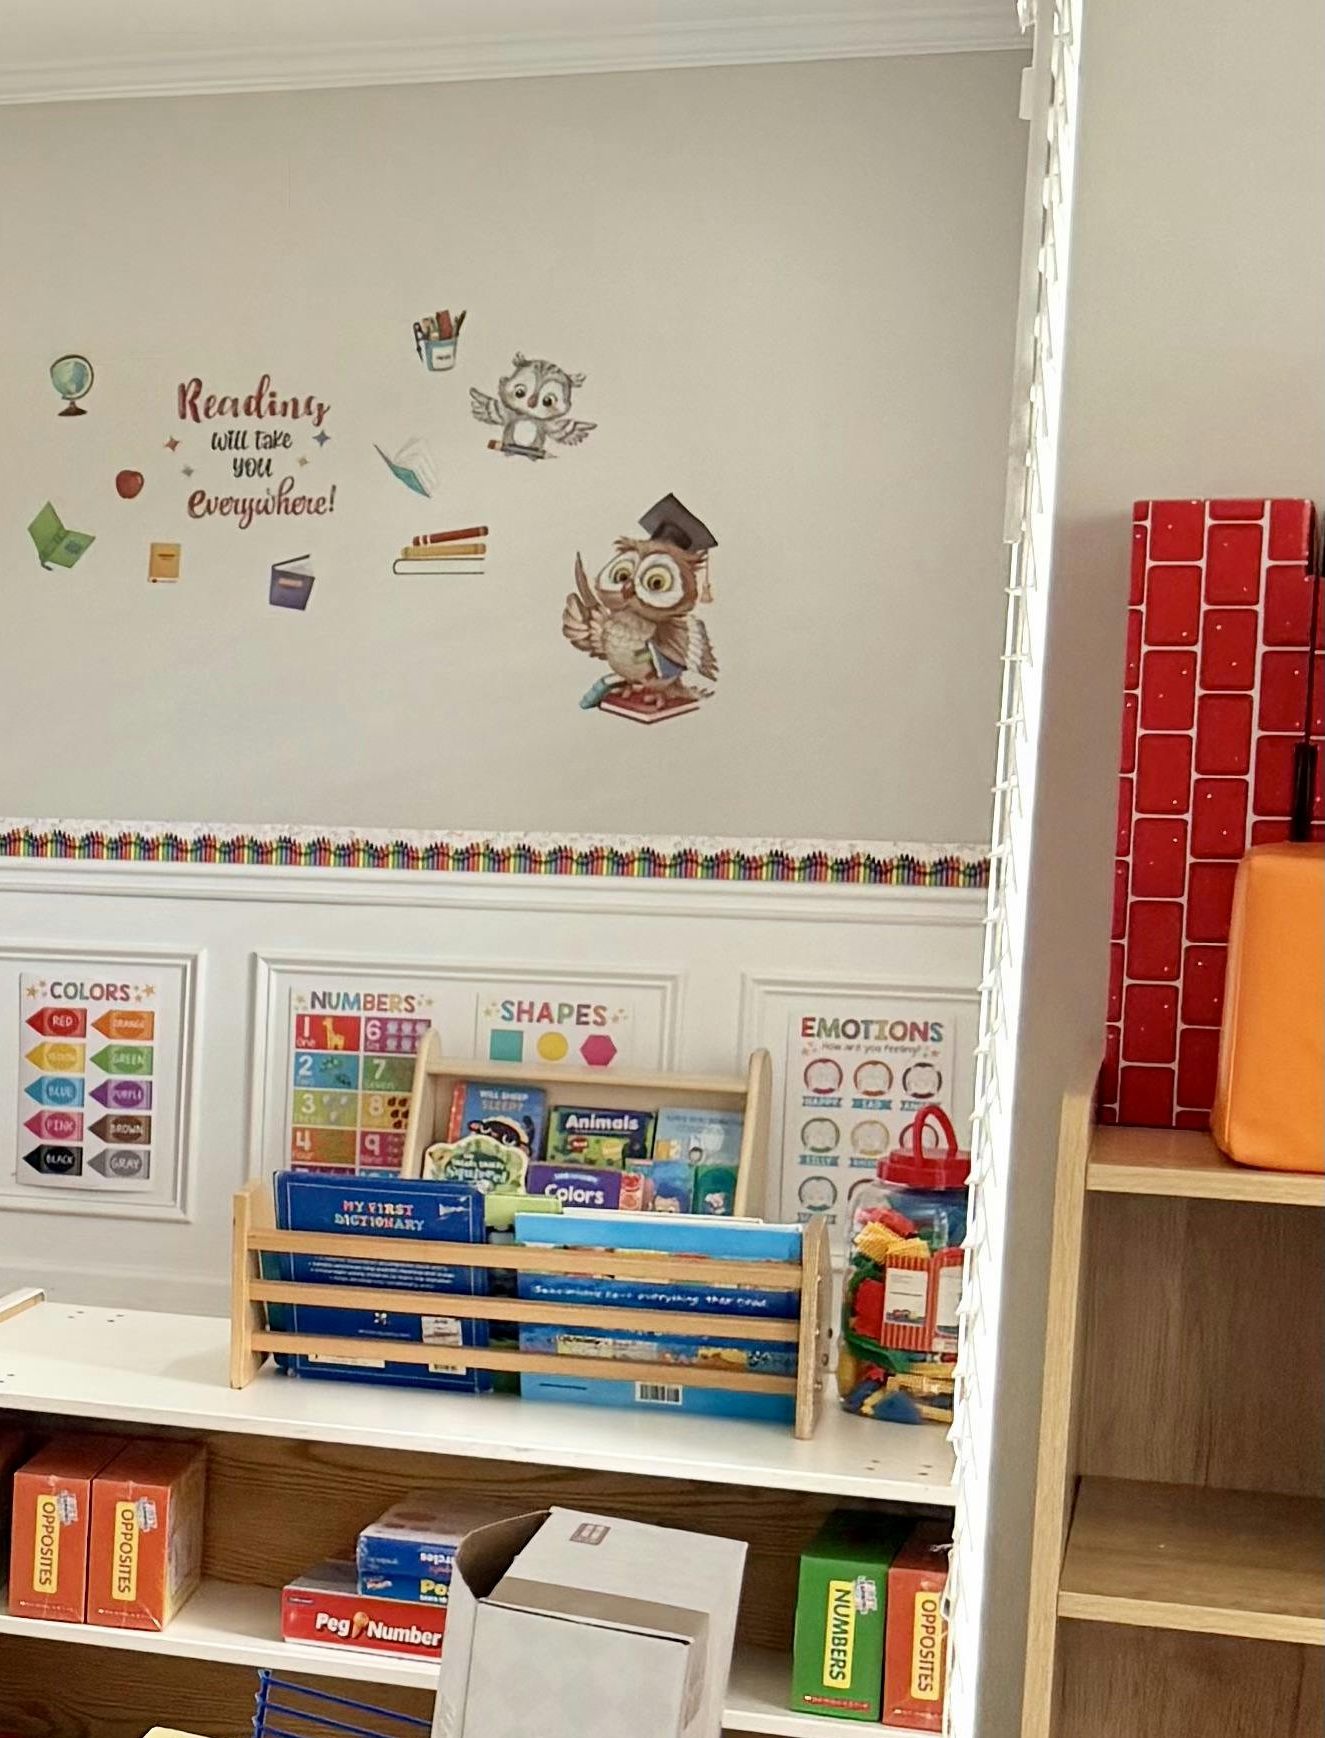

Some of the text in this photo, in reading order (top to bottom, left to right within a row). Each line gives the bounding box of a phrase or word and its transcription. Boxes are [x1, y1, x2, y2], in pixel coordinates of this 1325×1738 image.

[178, 374, 330, 427] Reading
[211, 430, 293, 450] will take
[233, 457, 273, 478] you
[187, 476, 337, 530] everywhere!
[50, 982, 131, 1002] COLORS
[310, 991, 416, 1013] NUMBERS
[52, 1016, 73, 1027] RED
[500, 999, 608, 1026] SHAPES
[303, 1016, 381, 1040] 1 6
[801, 1017, 944, 1042] EMOTIONS
[113, 1053, 144, 1065] GREEN
[298, 1055, 387, 1080] 2 7
[49, 1086, 73, 1098] BLUE
[302, 1093, 383, 1116] 3 8
[47, 1119, 144, 1135] PINK BROWN
[565, 1113, 639, 1131] Animals
[296, 1129, 380, 1155] 4 9
[46, 1154, 141, 1170] BLACK GRAY
[544, 1184, 604, 1205] Colors
[343, 1200, 414, 1218] MY FIRST
[335, 1213, 425, 1232] DICTIONARY
[38, 1501, 56, 1587] OPPOSITES
[117, 1508, 134, 1594] OPPOSITES
[315, 1612, 443, 1647] Peg Number
[829, 1588, 851, 1682] NUMBERS
[917, 1599, 937, 1692] OPPOSITES
